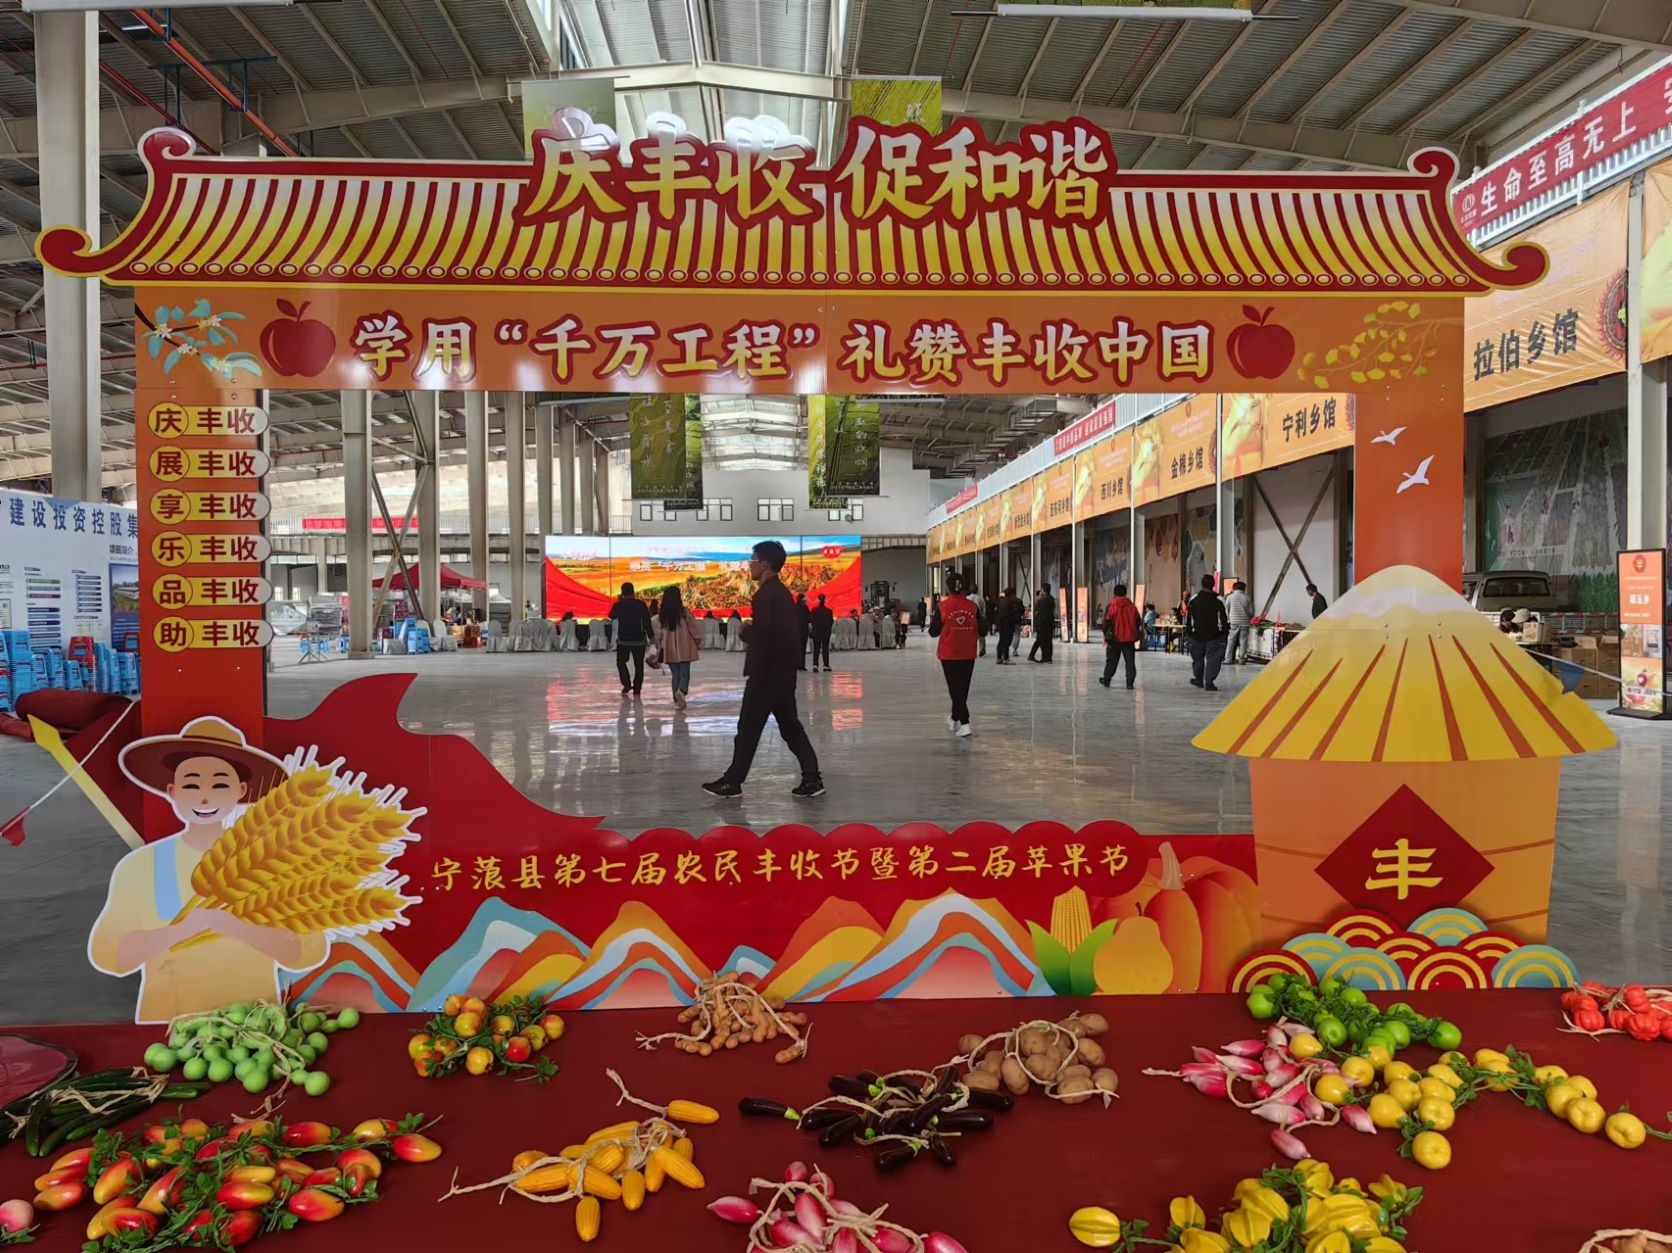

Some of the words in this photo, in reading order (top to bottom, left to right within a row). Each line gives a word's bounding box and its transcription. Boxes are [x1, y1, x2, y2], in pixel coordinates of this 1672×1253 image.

[523, 117, 813, 218] 庆丰收
[839, 124, 1108, 220] 促和谐
[1481, 101, 1637, 216] 生命至高无上
[842, 320, 1211, 382] 礼赞丰收中国
[1473, 308, 1579, 381] 拉伯乡馆
[155, 408, 256, 434] 庆丰收
[1282, 396, 1337, 443] 宁利乡馆
[155, 451, 256, 476] 展丰收
[10, 497, 138, 539] 建设投资控股集
[156, 494, 257, 519] 享丰收
[157, 537, 257, 562] 乐丰收
[158, 579, 258, 604] 品丰收
[159, 622, 259, 647] 助丰收
[431, 844, 1130, 891] 宁蒗县第七届农民丰收节暨第二届苹果节
[1365, 838, 1444, 901] 丰
